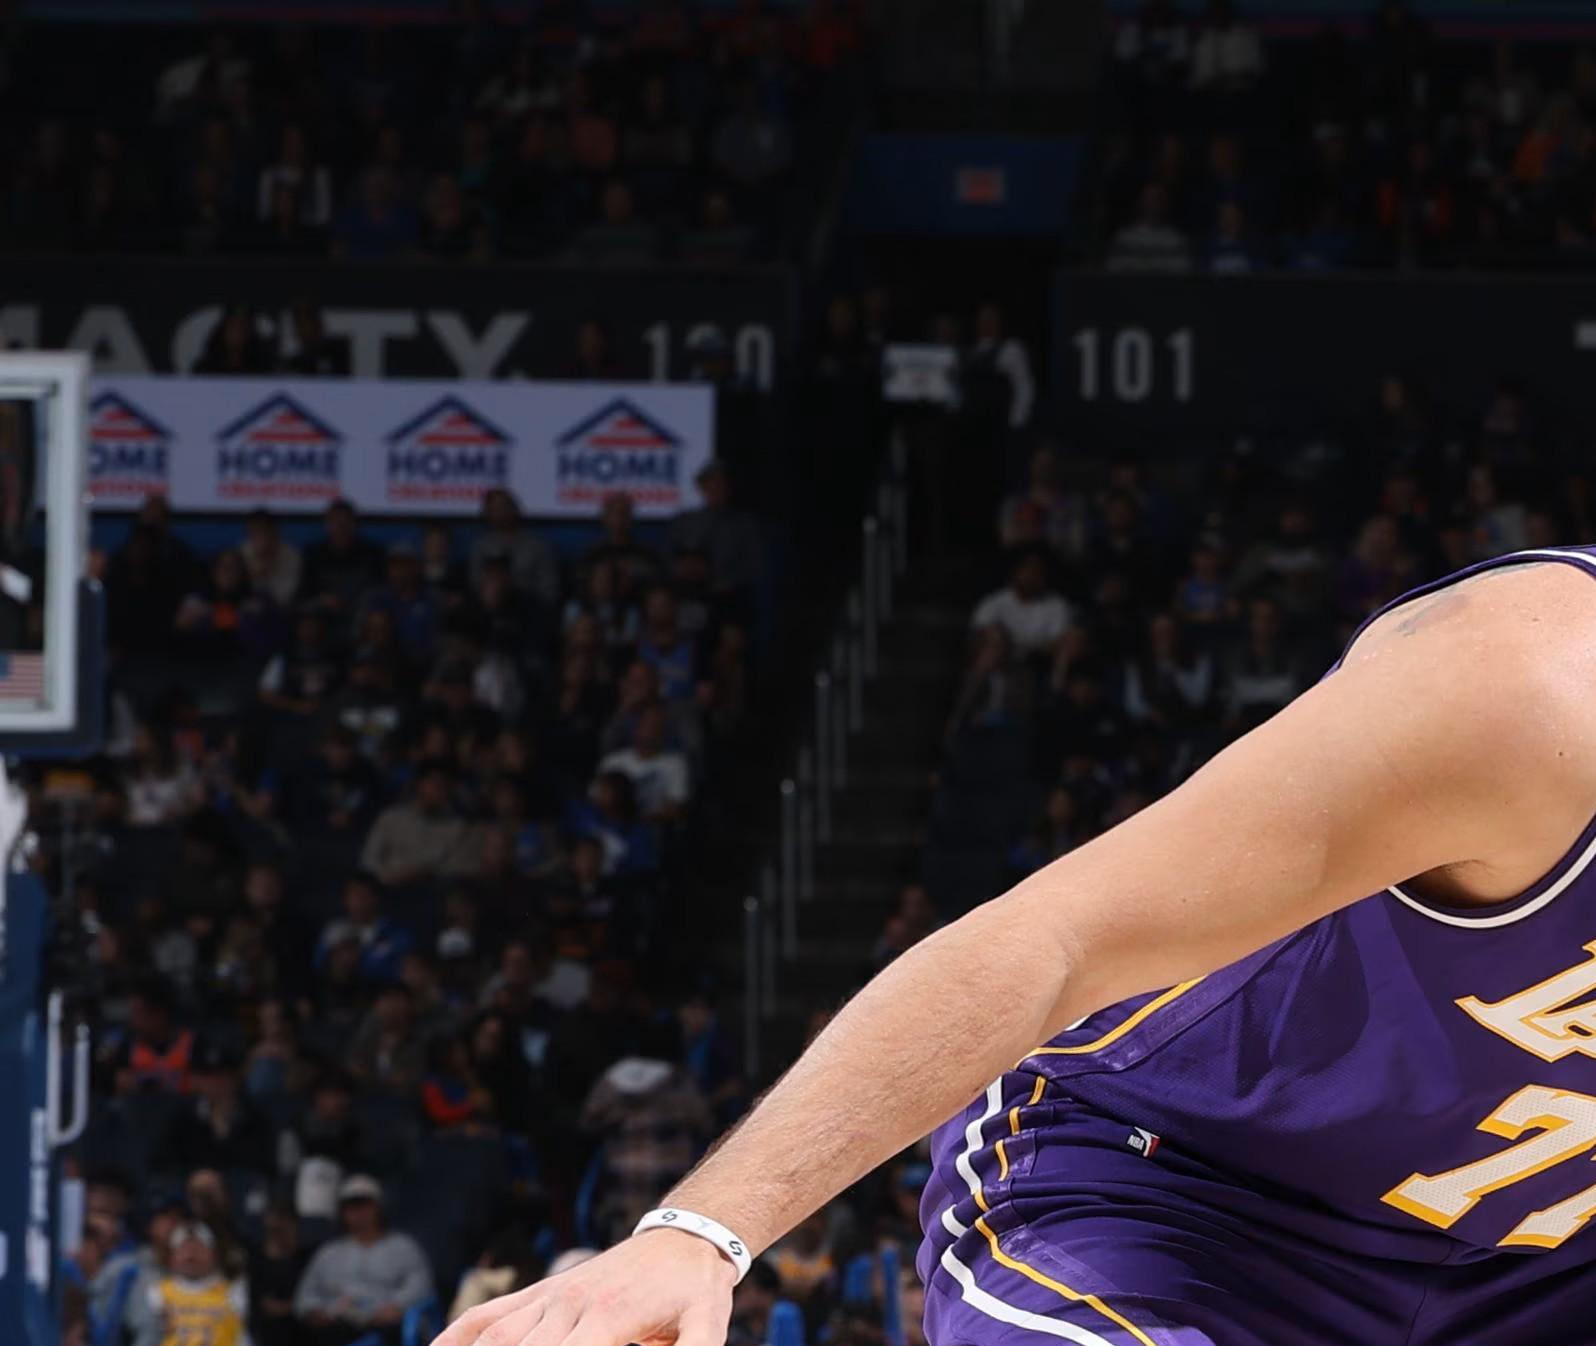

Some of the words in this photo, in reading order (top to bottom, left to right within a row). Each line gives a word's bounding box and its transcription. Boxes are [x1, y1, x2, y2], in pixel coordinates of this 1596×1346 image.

[1072, 325, 1195, 403] 101
[90, 447, 168, 476] OME
[218, 449, 339, 477] HOME
[388, 452, 508, 479] HOME
[558, 454, 680, 481] HOME
